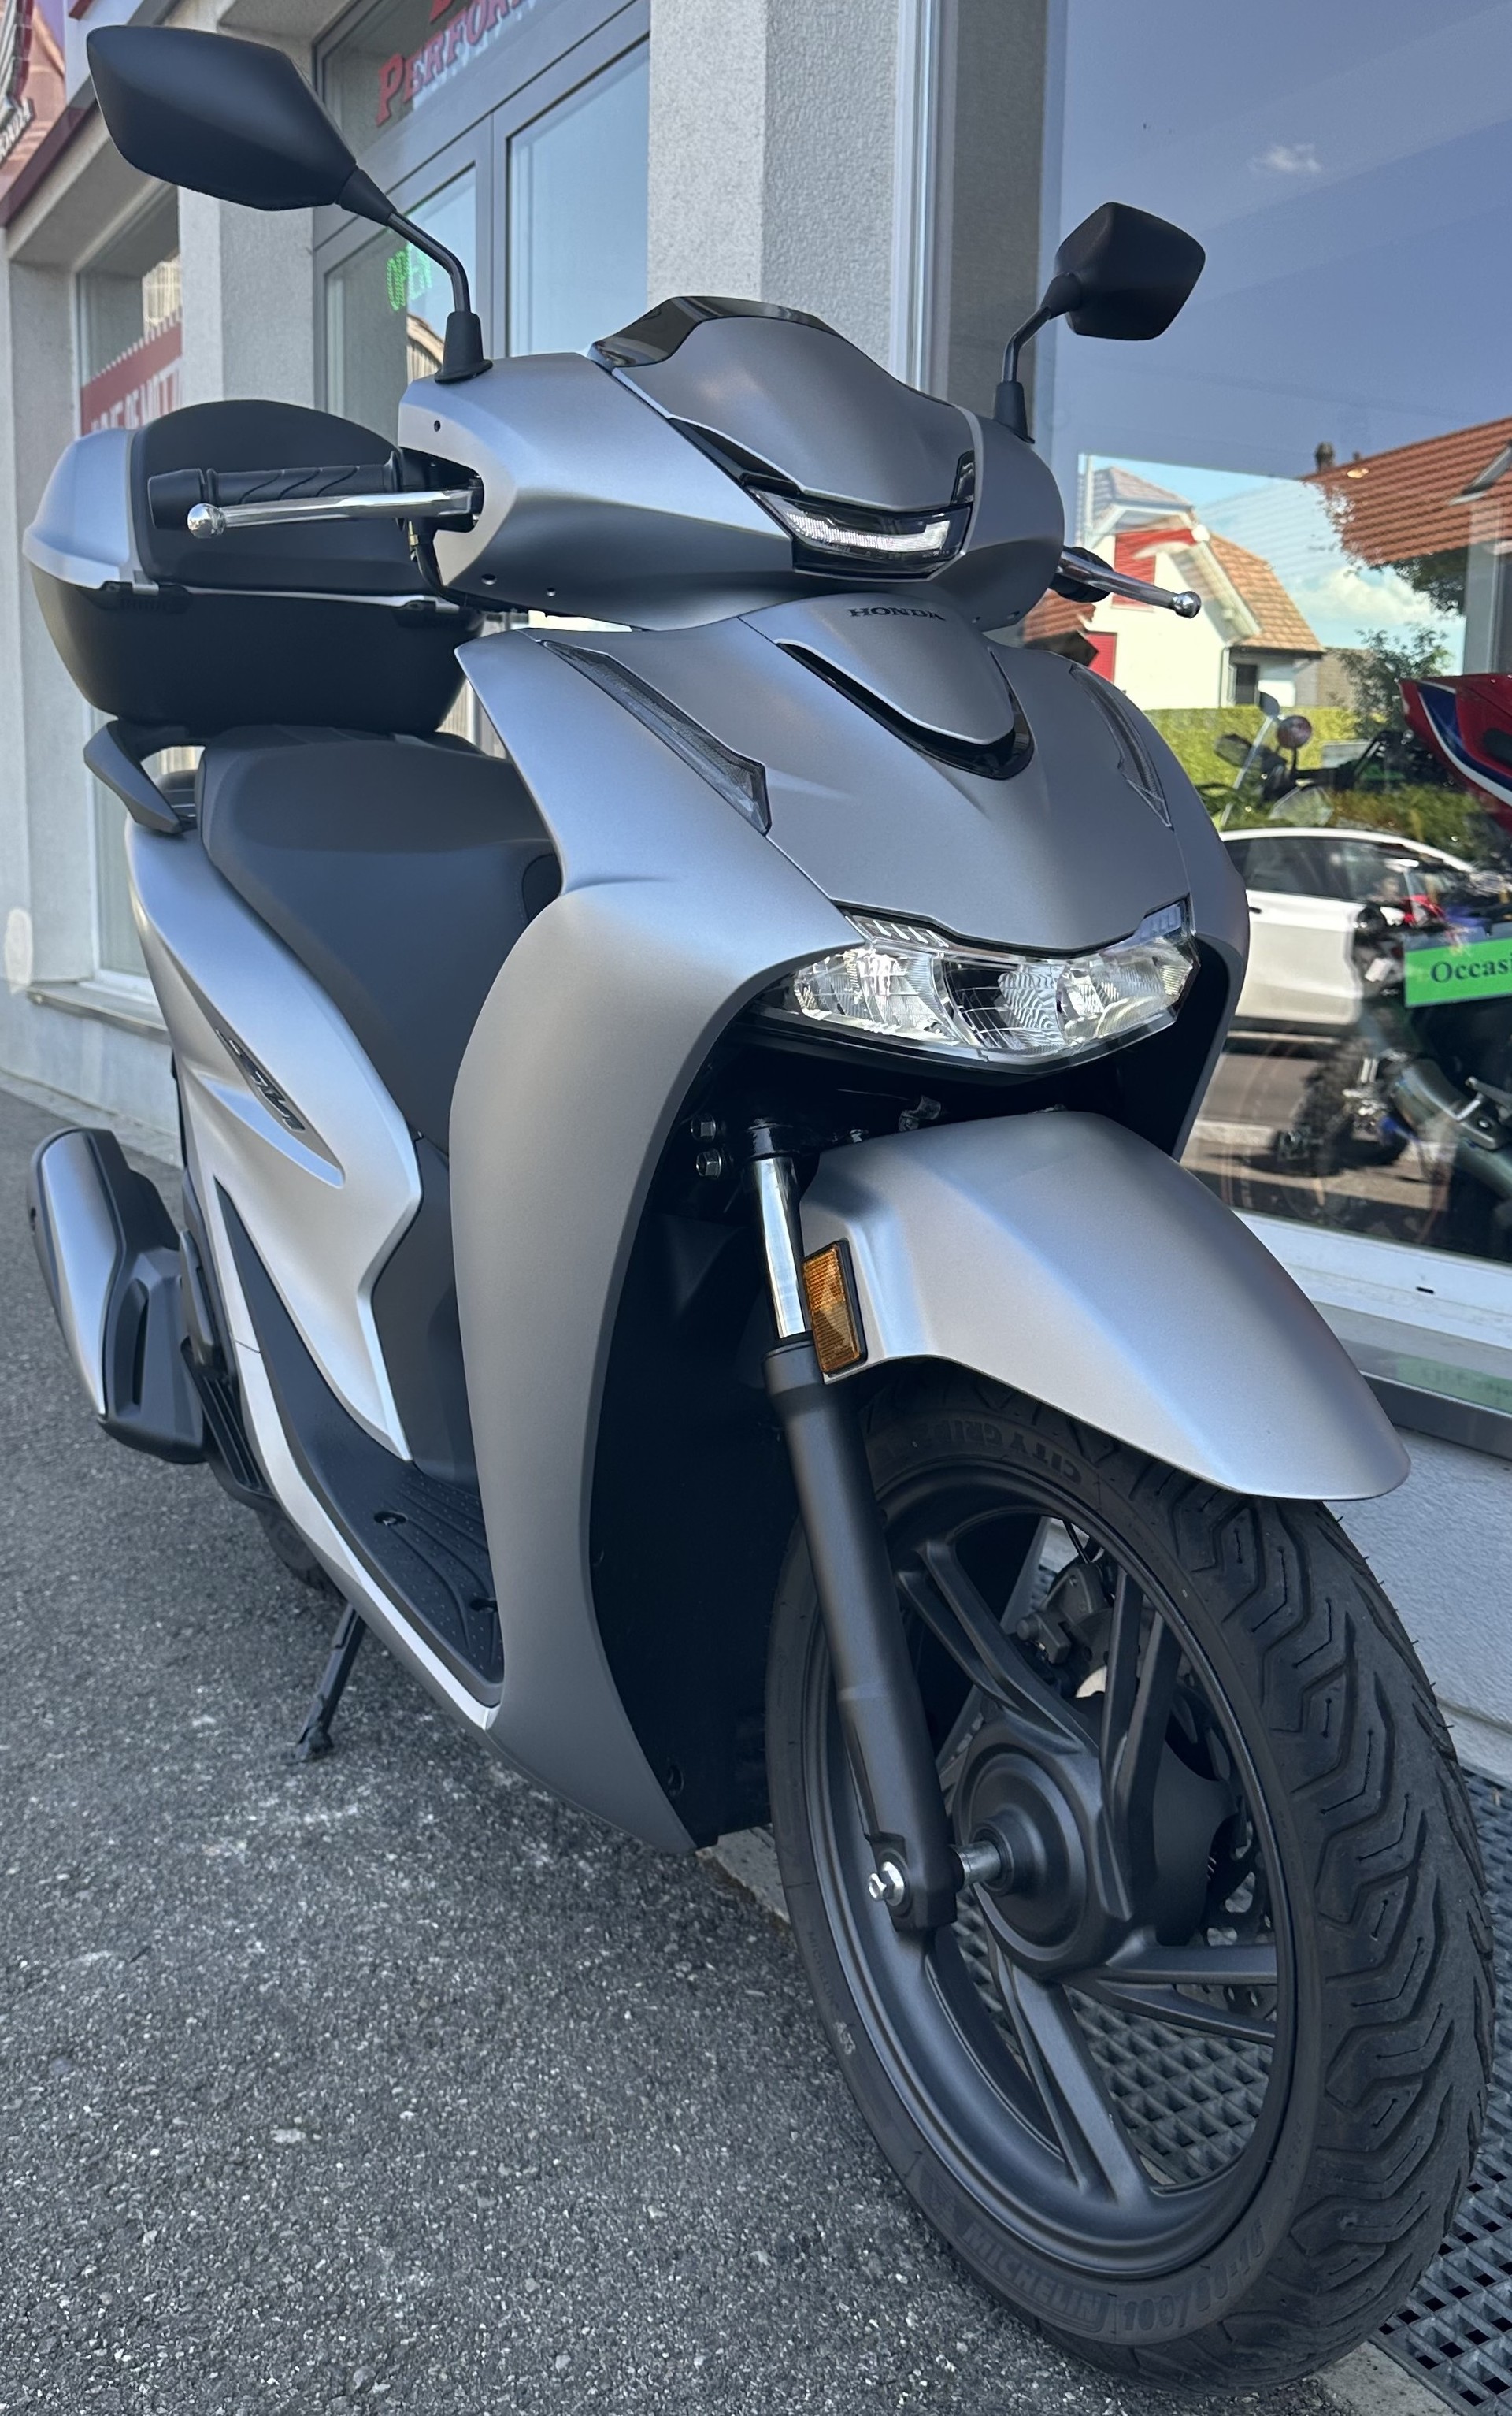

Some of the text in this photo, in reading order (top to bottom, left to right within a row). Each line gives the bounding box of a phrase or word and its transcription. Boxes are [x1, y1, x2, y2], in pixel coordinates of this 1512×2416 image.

[847, 606, 947, 622] HONDA
[1010, 1431, 1082, 1486] CITY
[962, 2221, 1104, 2323] MICHELIN
